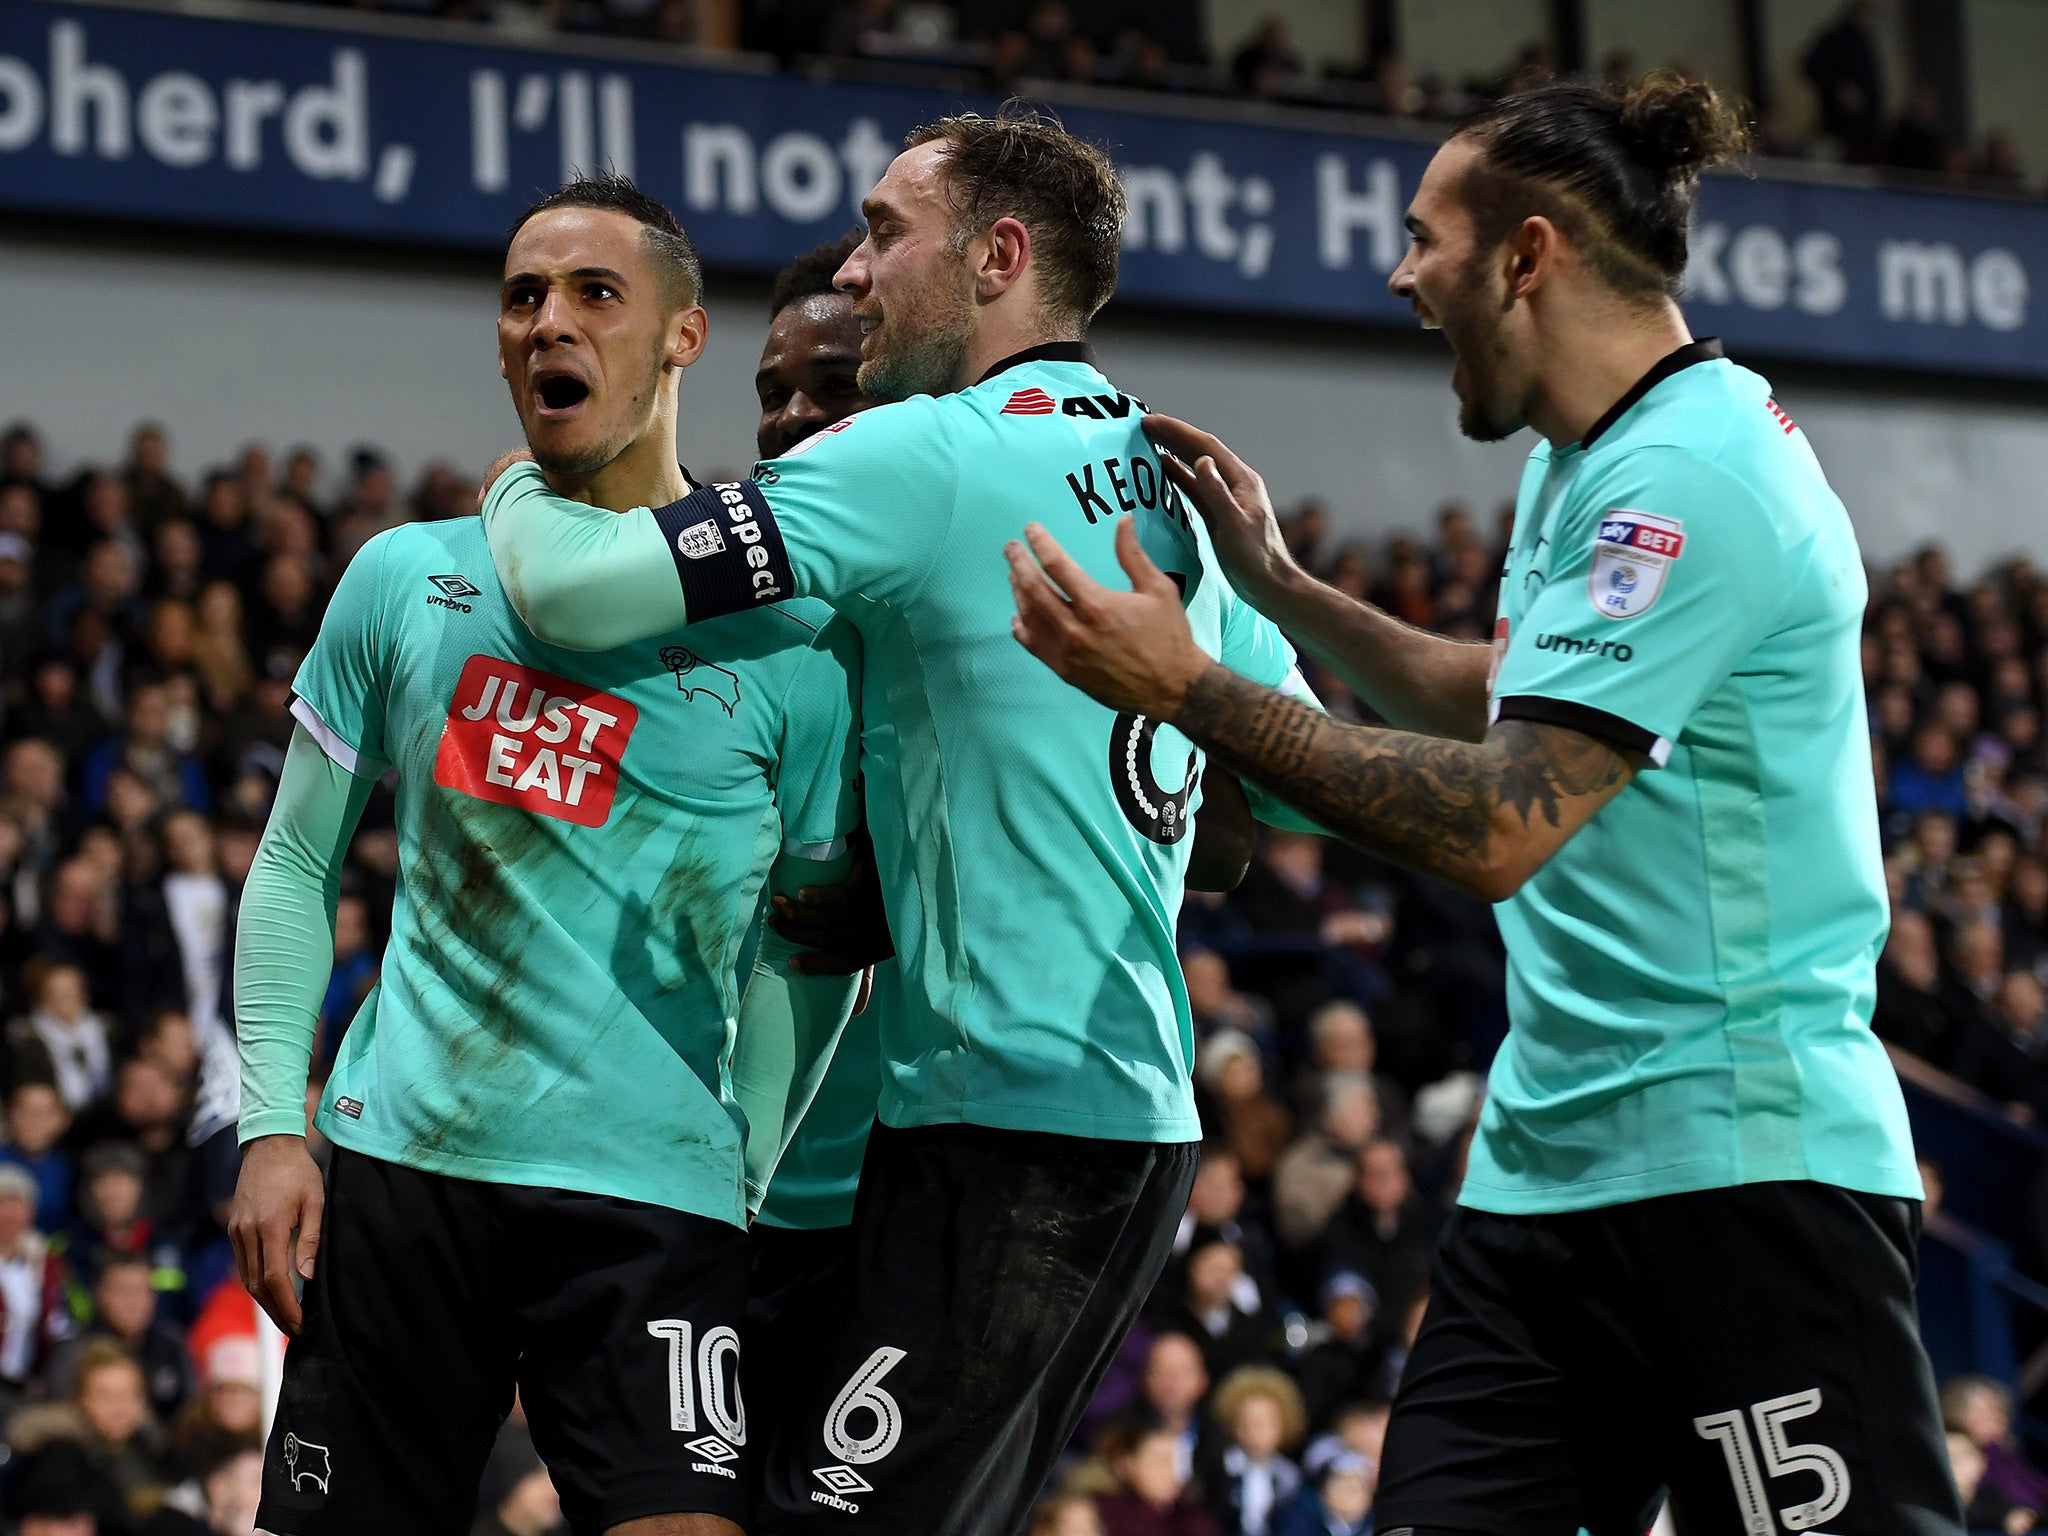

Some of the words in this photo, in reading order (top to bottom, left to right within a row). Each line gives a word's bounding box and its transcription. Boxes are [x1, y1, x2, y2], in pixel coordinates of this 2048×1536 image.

[682, 116, 895, 223] not
[1118, 152, 1275, 280] nt;
[1314, 153, 1400, 275] H
[1680, 219, 1848, 318] kes
[1876, 238, 2029, 333] me
[701, 480, 782, 600] Respect
[1637, 528, 1681, 553] BET
[426, 595, 472, 614] umbro
[1605, 594, 1628, 611] EFL
[1535, 633, 1633, 663] umbro
[461, 674, 619, 754] JUST
[484, 732, 602, 807] EAT
[1161, 825, 1176, 838] EFL
[646, 1318, 747, 1447] 10
[822, 1346, 908, 1465] 6
[691, 1462, 737, 1480] umbro
[1692, 1387, 1851, 1536] 15
[810, 1490, 860, 1515] umbro
